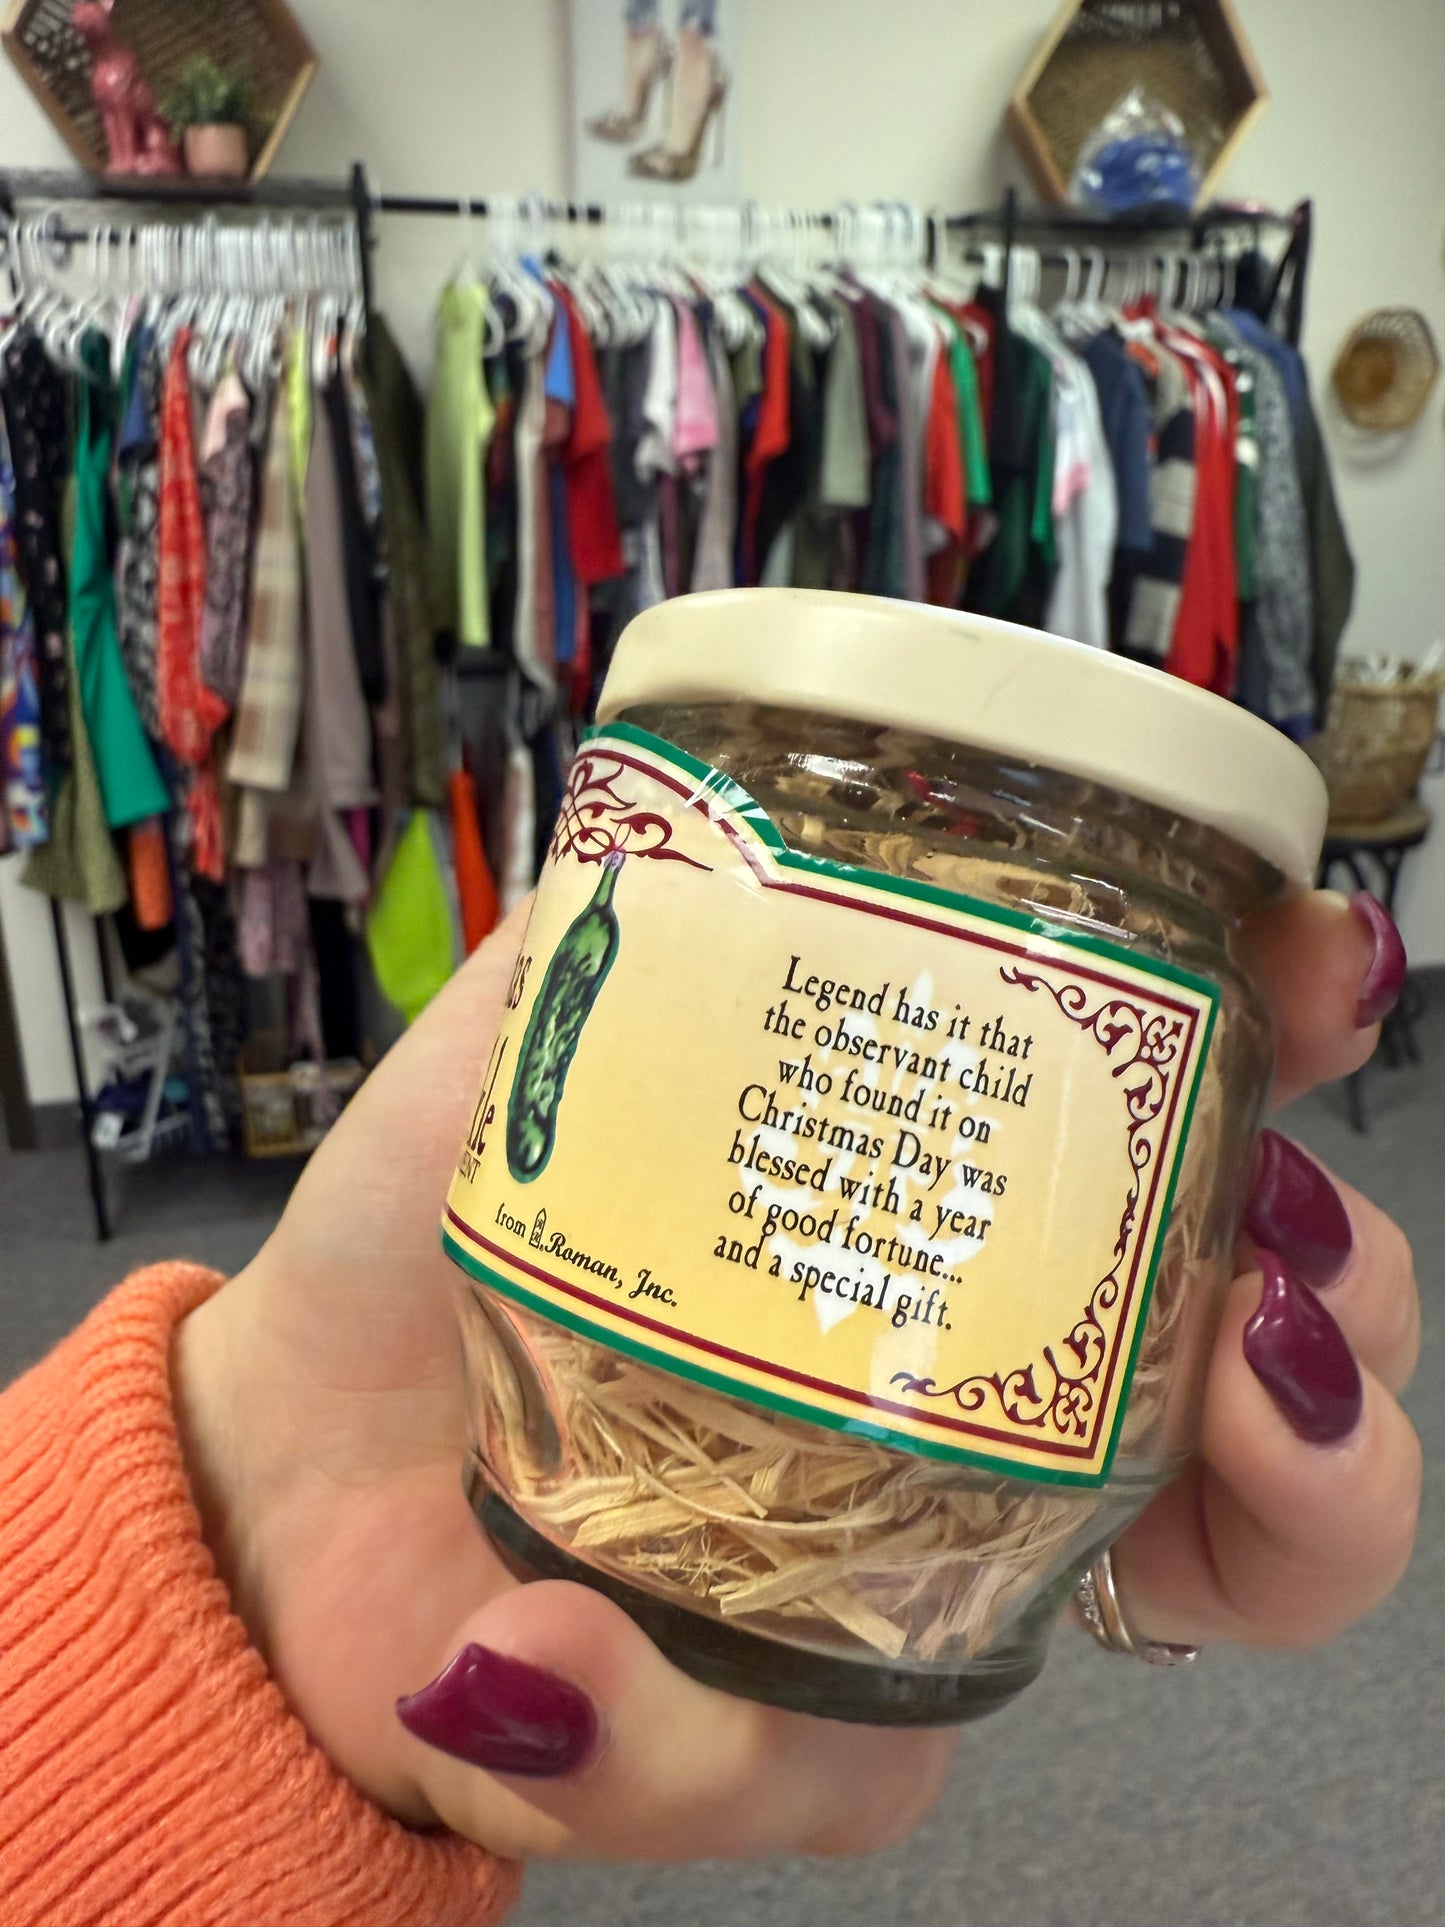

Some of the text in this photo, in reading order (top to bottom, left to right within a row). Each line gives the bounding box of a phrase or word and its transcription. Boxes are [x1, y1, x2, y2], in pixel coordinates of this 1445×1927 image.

[763, 999, 1034, 1108] the observant child
[781, 954, 1034, 1060] Legend has it that
[738, 1083, 1008, 1196] Christmas Day was
[778, 1053, 991, 1144] who found it on
[727, 1128, 992, 1241] blessed with a year
[728, 1184, 963, 1284] of good fortune...
[494, 1202, 526, 1239] from
[544, 1232, 623, 1289] Roman,
[713, 1233, 952, 1331] and a special gift.
